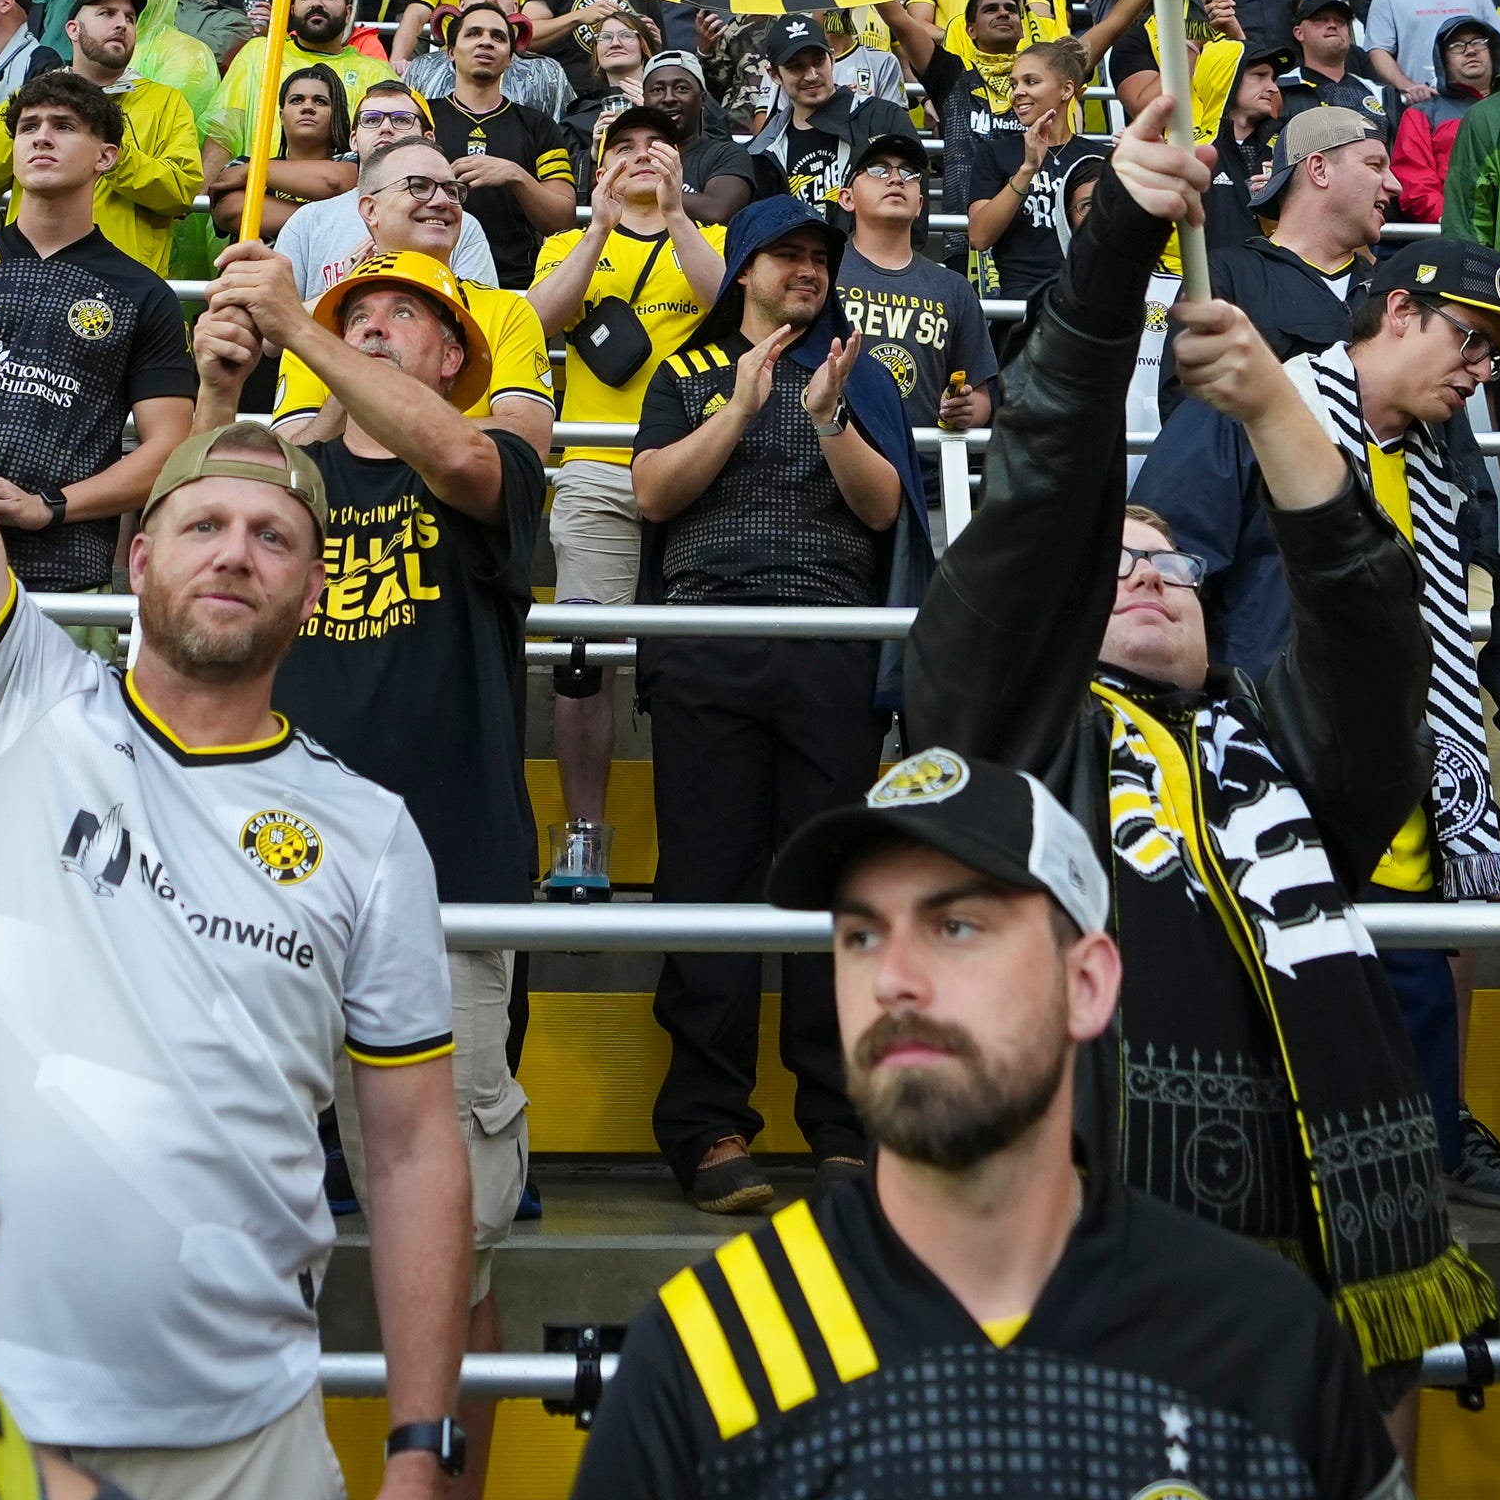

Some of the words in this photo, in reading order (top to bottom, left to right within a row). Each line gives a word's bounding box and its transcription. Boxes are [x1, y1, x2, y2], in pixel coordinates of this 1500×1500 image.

[992, 117, 1032, 132] Nation
[813, 161, 841, 201] CRE
[75, 300, 110, 322] COLUMBUS
[632, 299, 700, 316] tionwide
[835, 285, 945, 316] COLUMBUS
[71, 317, 90, 336] CREW
[94, 327, 105, 337] SC
[842, 300, 916, 340] REW
[914, 311, 949, 351] SC
[871, 346, 914, 371] OLUMBUS
[899, 379, 911, 393] SC
[320, 534, 396, 576] ELL
[322, 605, 416, 641] COLUMBUS!
[1451, 799, 1472, 822] SC
[247, 811, 318, 848] COLUMBUS
[269, 829, 284, 845] 96
[244, 846, 283, 880] CREW
[293, 859, 313, 878] SC
[139, 852, 315, 969] Naonwide
